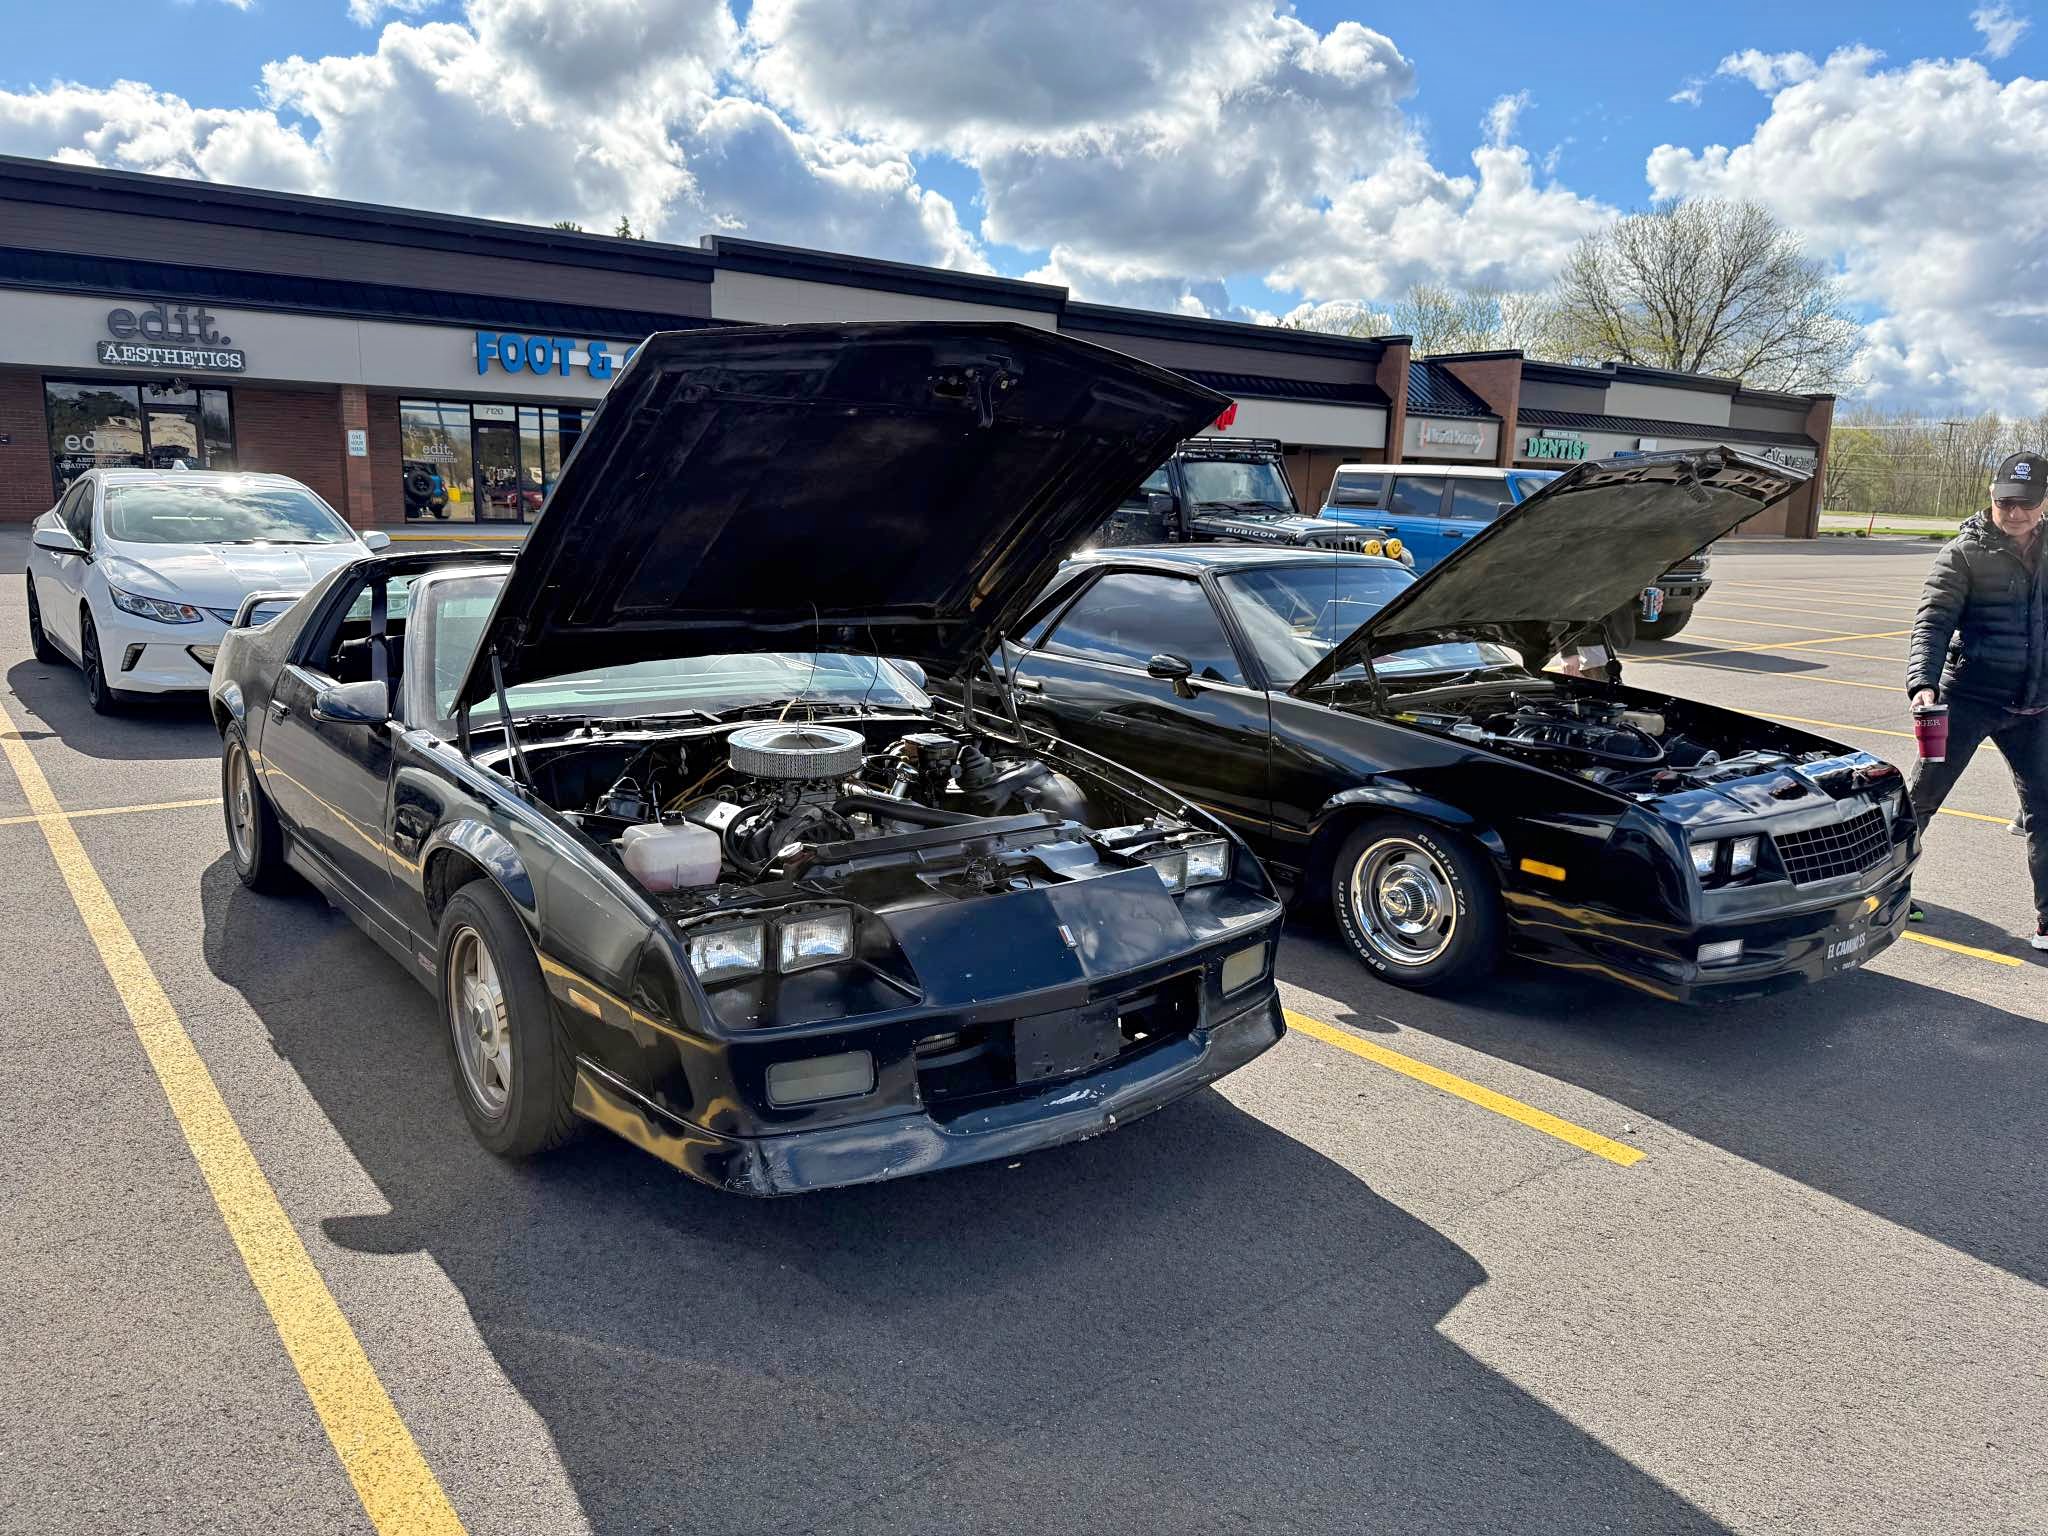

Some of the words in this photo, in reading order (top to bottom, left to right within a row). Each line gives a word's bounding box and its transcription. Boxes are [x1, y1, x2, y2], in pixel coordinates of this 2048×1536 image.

[107, 303, 231, 345] edit.
[102, 343, 242, 368] AESTHETICS
[475, 331, 576, 376] FOOT
[587, 341, 613, 379] &
[422, 443, 454, 455] edit.
[1527, 437, 1592, 461] DENTIST
[1225, 526, 1278, 539] RUBICON
[1456, 887, 1466, 916] T/A
[1827, 944, 1834, 959] EL
